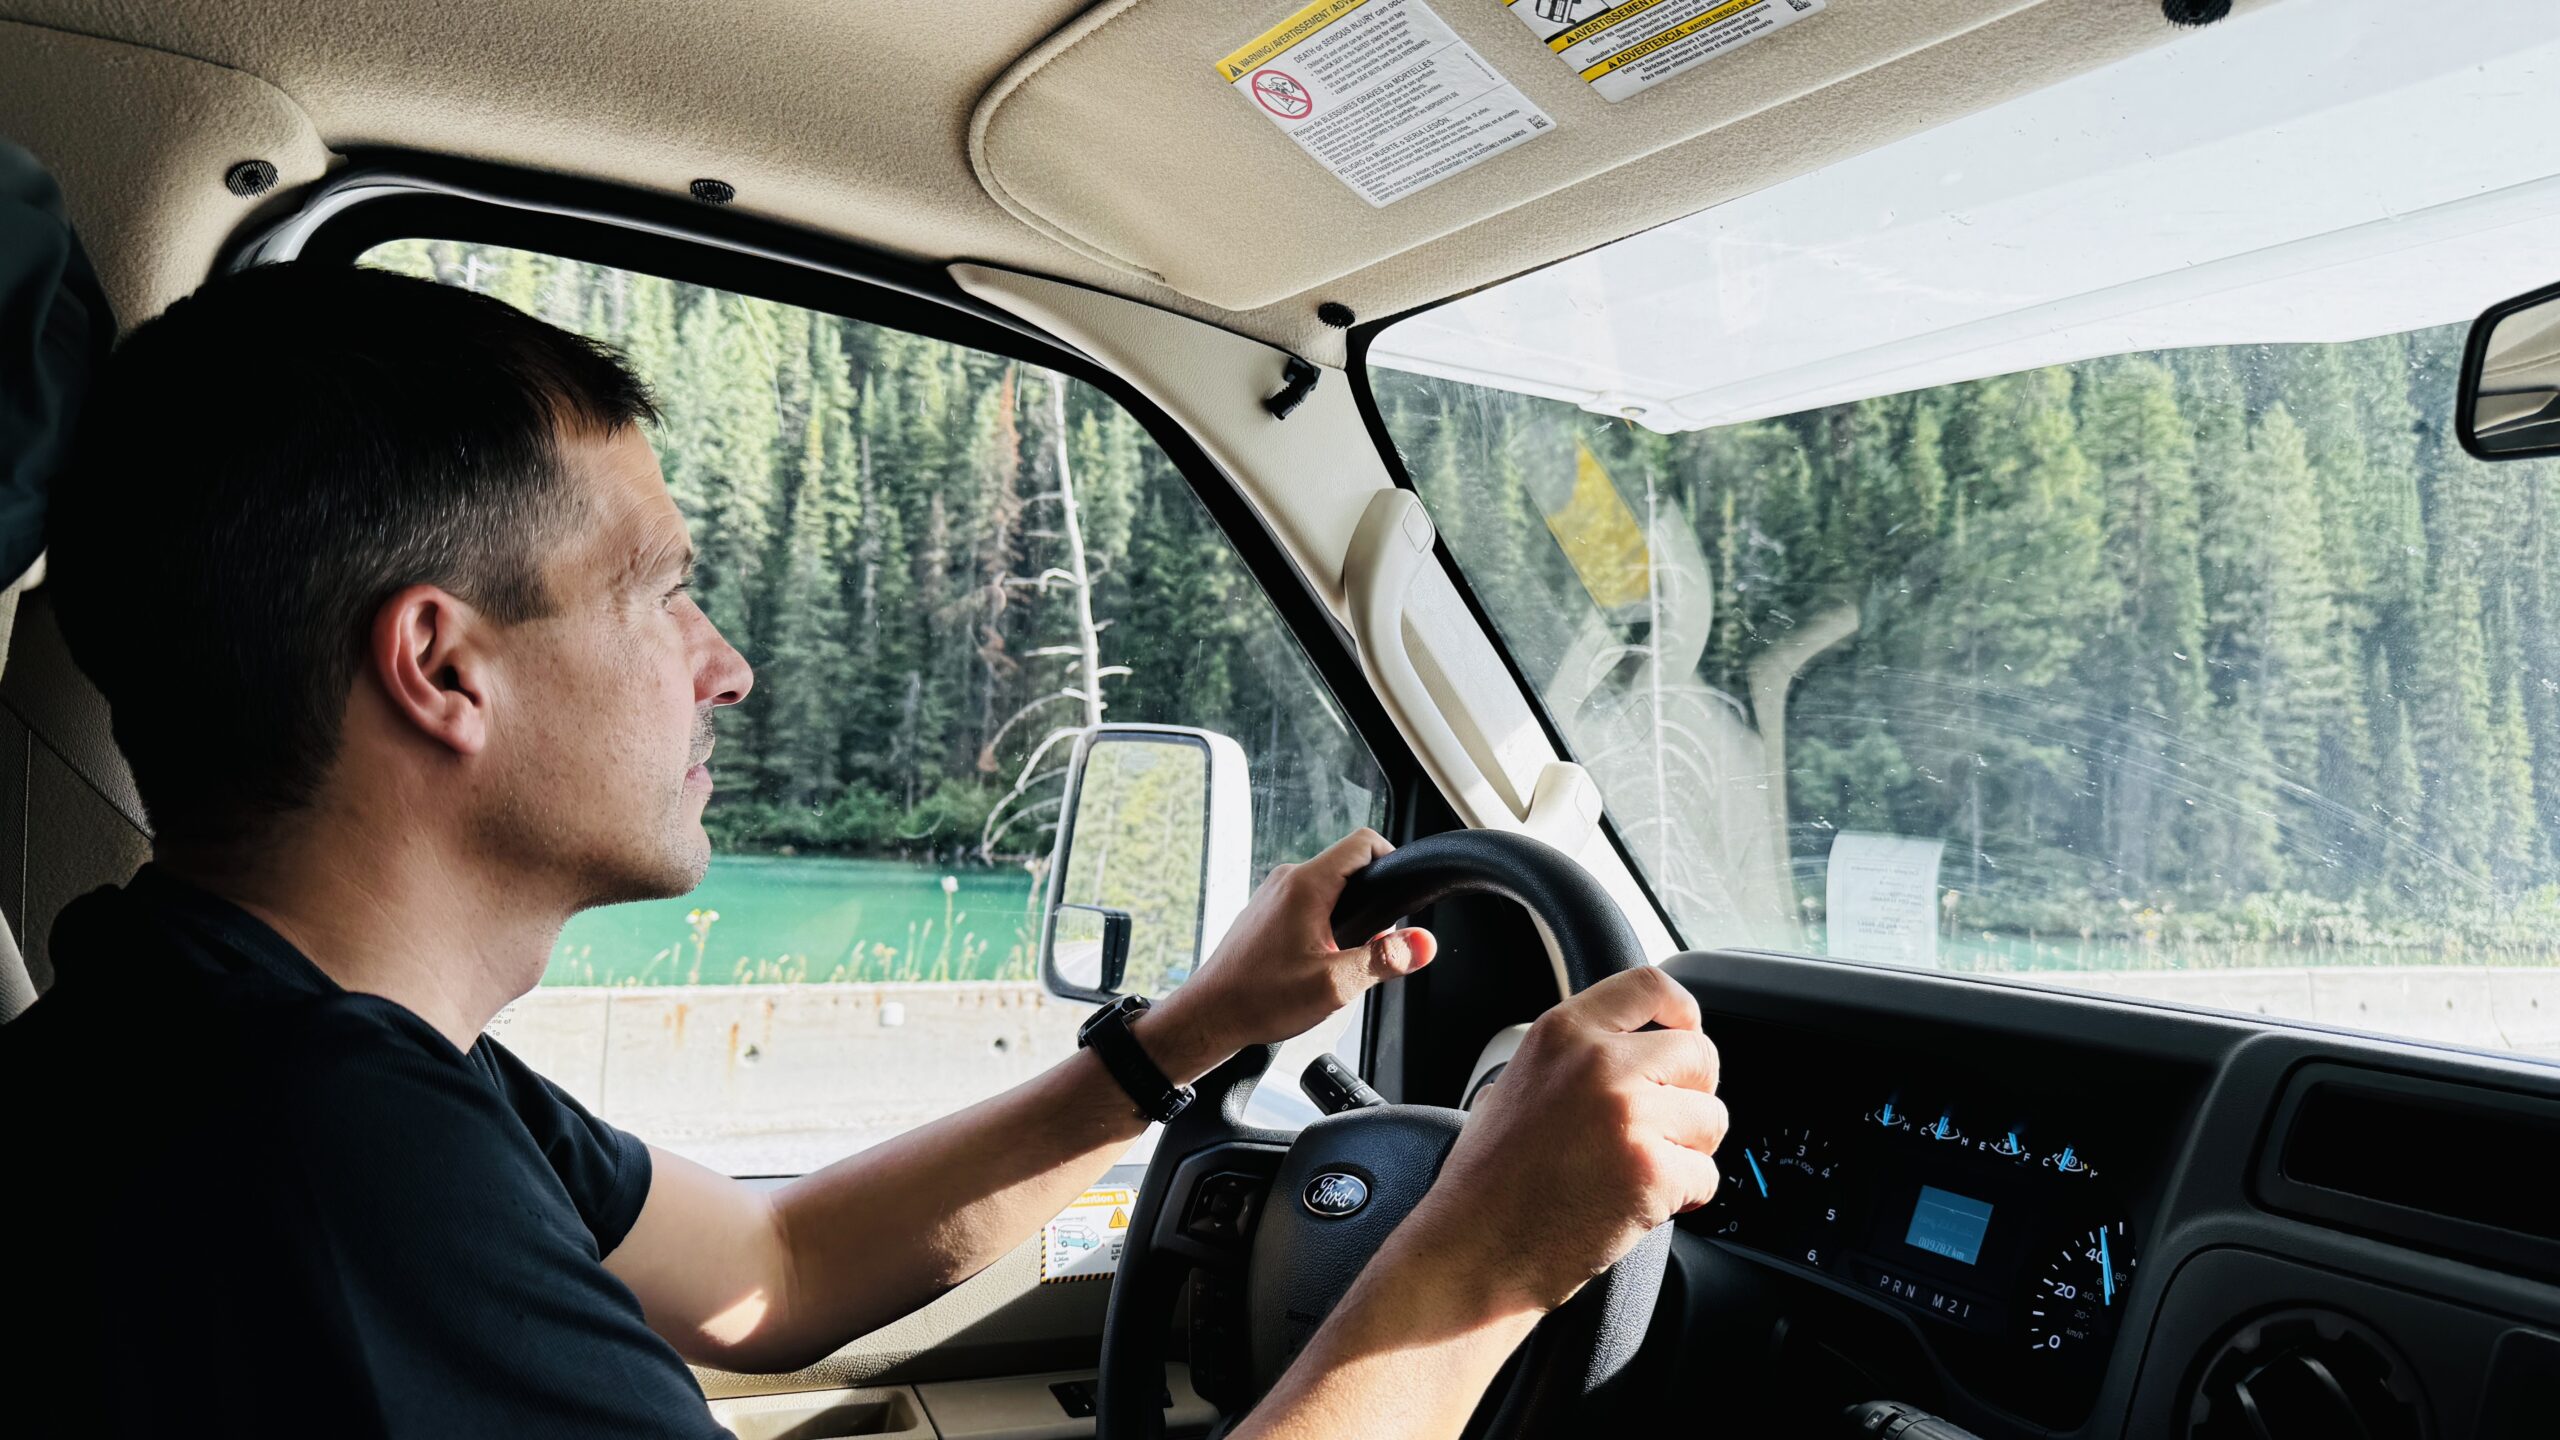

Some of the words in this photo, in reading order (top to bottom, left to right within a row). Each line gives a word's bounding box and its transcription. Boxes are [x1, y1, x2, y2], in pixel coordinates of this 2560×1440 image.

[1294, 48, 1316, 63] DEATH
[1322, 27, 1351, 46] SERIOUS
[1350, 13, 1375, 30] INJURY
[1375, 6, 1389, 16] can
[1616, 29, 1685, 64] ADVERTENCIA:
[1688, 17, 1712, 30] MAYOR
[1712, 5, 1739, 19] RIESGO
[1238, 45, 1272, 67] WARNING
[1321, 101, 1358, 123] BLESSURES
[1356, 87, 1384, 103] GRAVES
[1338, 159, 1365, 175] PELIGRO
[1372, 142, 1400, 158] MUERTE
[1403, 130, 1425, 142] SERIA
[1920, 1127, 1927, 1136] C
[1961, 1138, 1969, 1147] H
[1761, 1151, 1771, 1162] 2
[1796, 1145, 1806, 1157] 3
[1979, 1142, 1986, 1151] E
[2024, 1153, 2031, 1162] F
[2043, 1158, 2050, 1166] C
[1821, 1167, 1831, 1179] 4
[1312, 1177, 1355, 1207] Ford
[1826, 1209, 1836, 1221] 5
[1729, 1221, 1738, 1232] 0
[1951, 1247, 1965, 1260] km
[2115, 1272, 2127, 1282] 80
[2054, 1282, 2076, 1299] 20
[2048, 1335, 2061, 1349] 0
